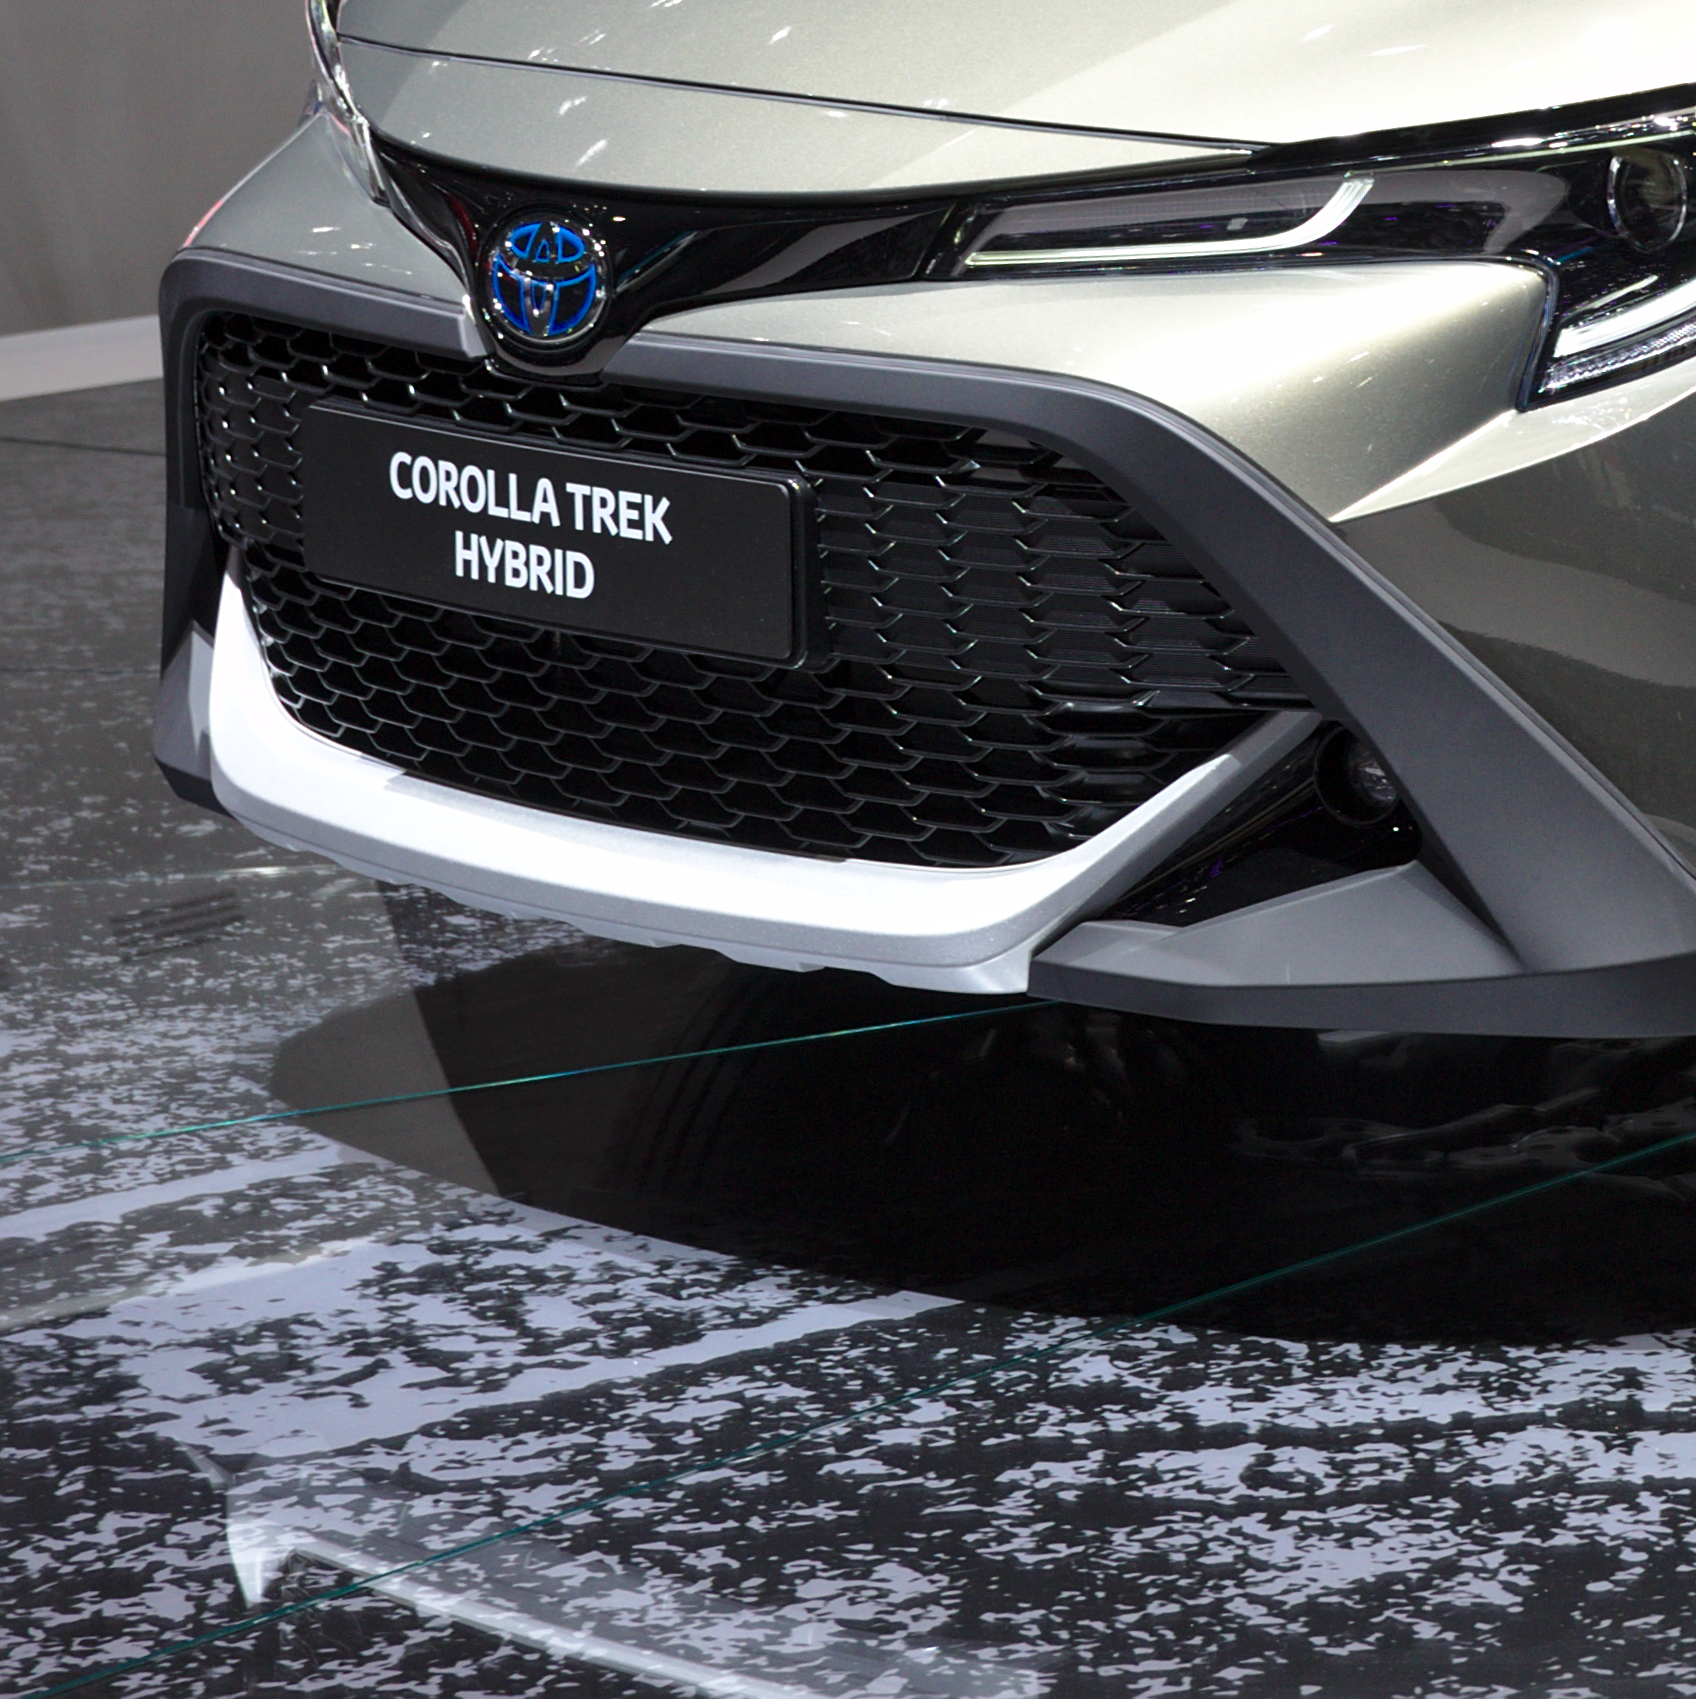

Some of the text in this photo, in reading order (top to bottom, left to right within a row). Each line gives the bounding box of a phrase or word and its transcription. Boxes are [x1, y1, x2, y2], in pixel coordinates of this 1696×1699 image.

[388, 450, 674, 546] COROLLA TREK
[454, 529, 596, 600] HYBRID
